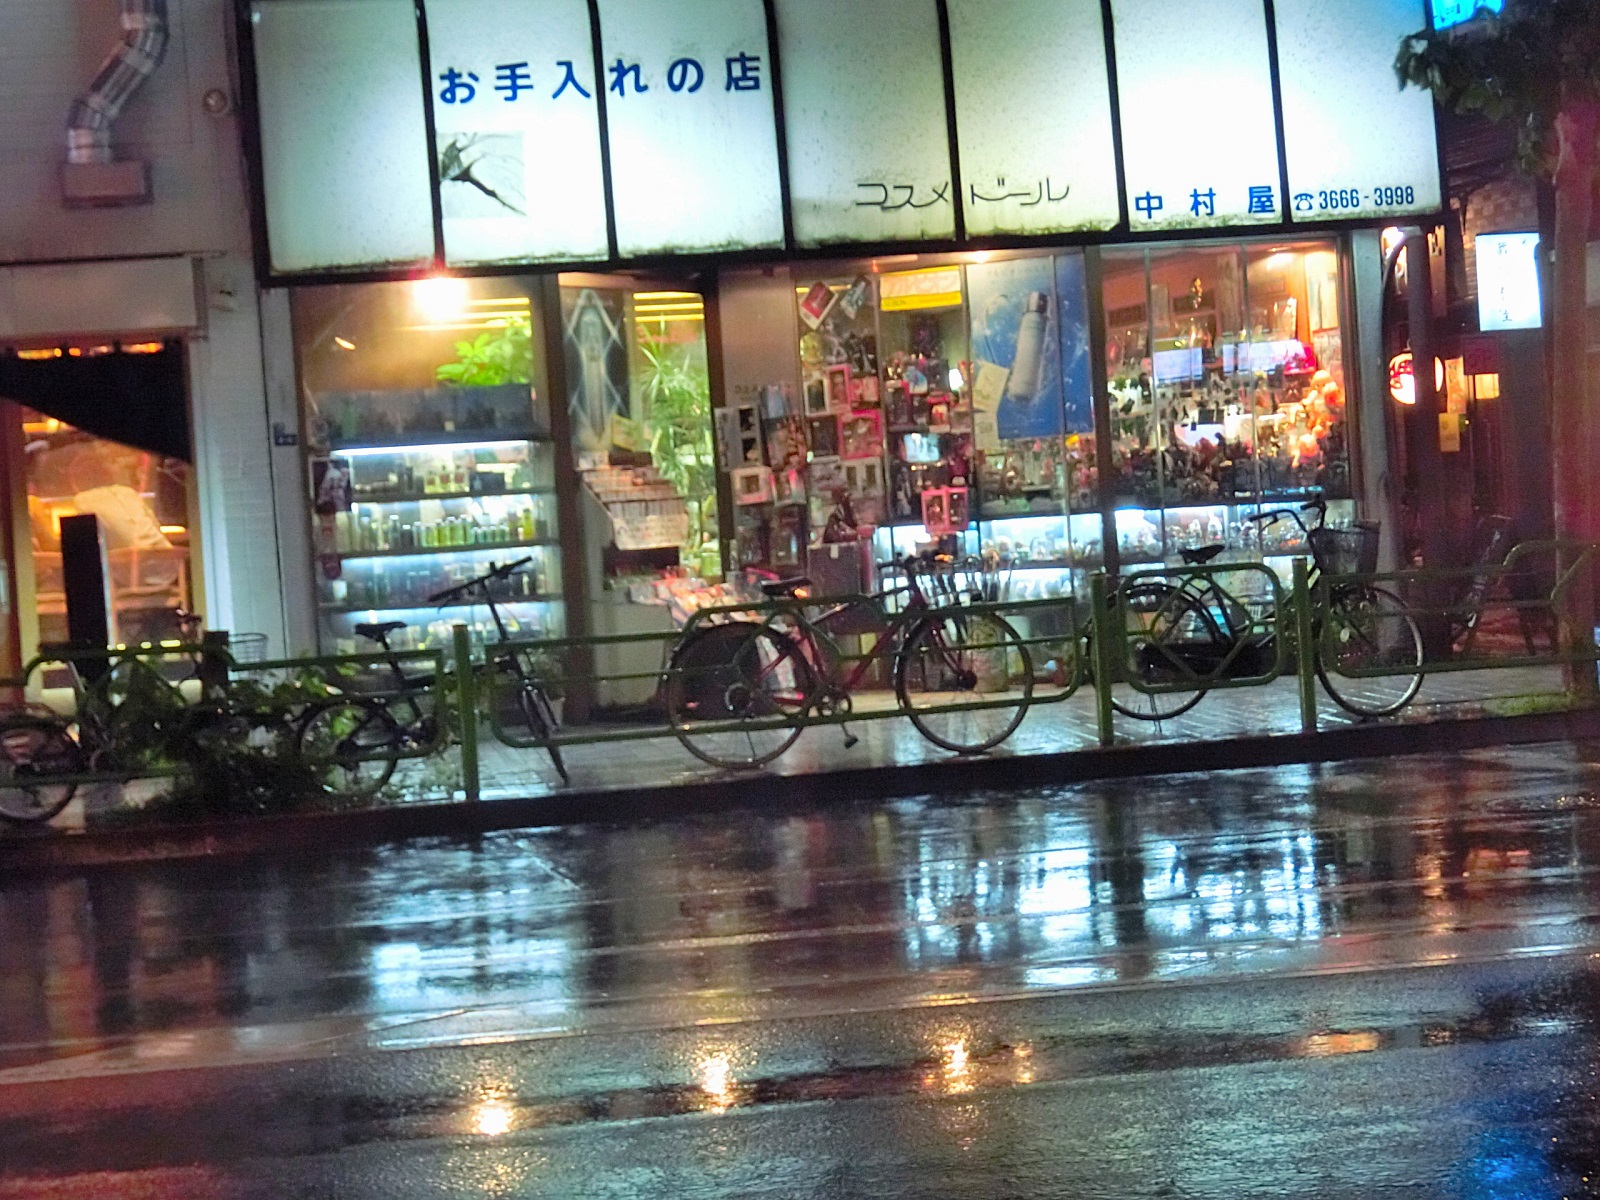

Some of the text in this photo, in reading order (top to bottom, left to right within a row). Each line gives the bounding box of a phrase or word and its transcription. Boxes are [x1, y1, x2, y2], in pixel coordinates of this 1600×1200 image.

[439, 51, 762, 104] お手入れの店
[1134, 185, 1277, 219] 中村屋
[1318, 185, 1415, 210] 3666-3998
